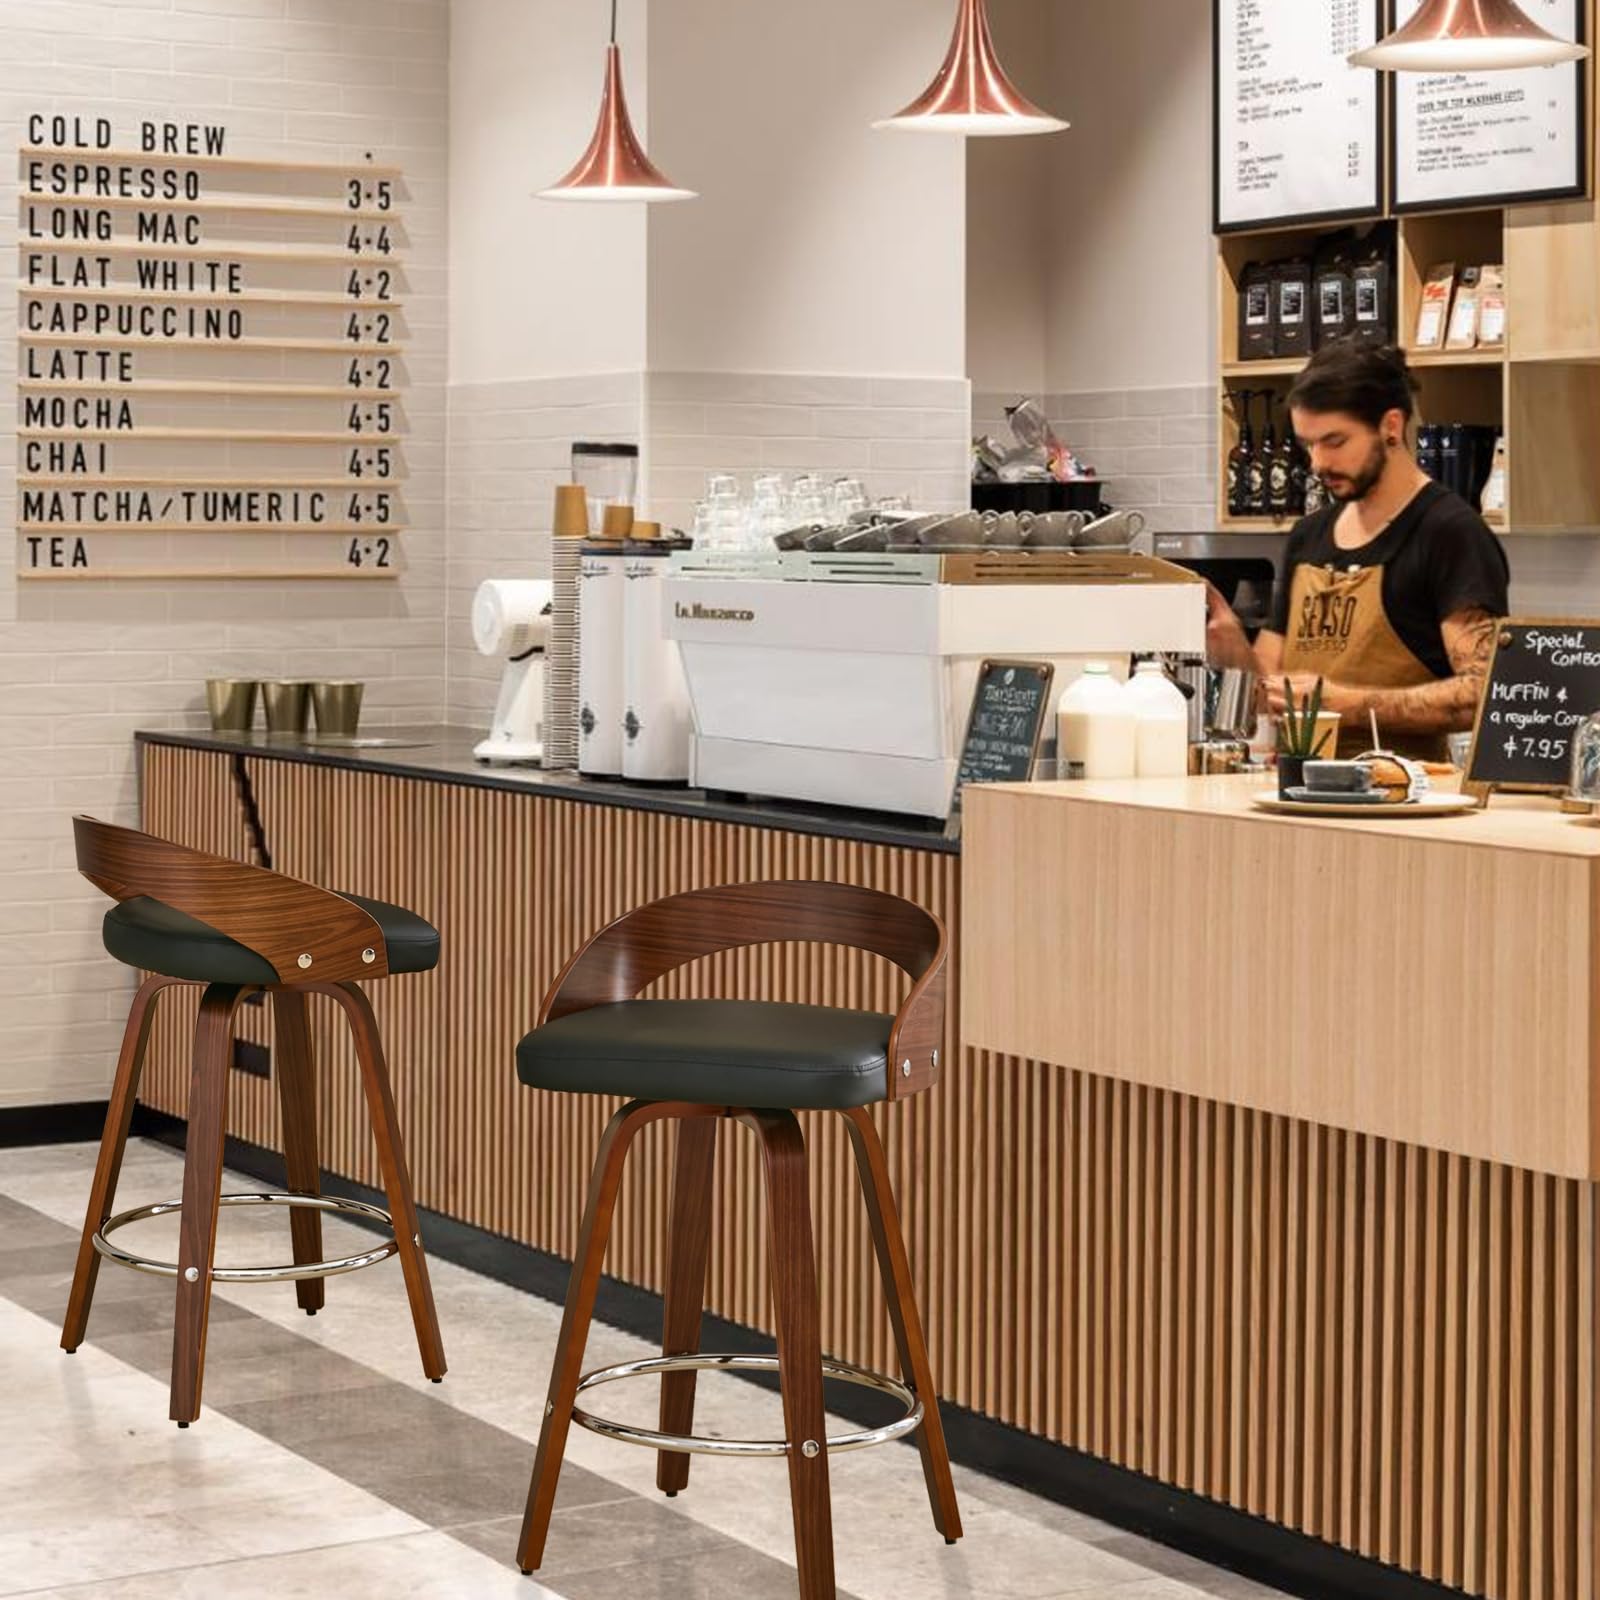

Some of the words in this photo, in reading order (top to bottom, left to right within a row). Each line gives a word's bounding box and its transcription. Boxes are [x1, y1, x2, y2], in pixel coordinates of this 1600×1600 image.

[29, 114, 111, 149] COLD
[142, 122, 225, 156] BREW
[29, 161, 199, 201] ESPRESSO
[29, 206, 111, 241] LONG
[138, 211, 200, 245] MAC
[29, 254, 111, 287] FLAT
[137, 259, 241, 293] WHITE
[28, 300, 242, 340] CAPPUCCINO
[28, 347, 133, 382] LATTE
[25, 397, 133, 430] MOCHA
[26, 441, 106, 473] CHAI
[23, 490, 325, 523] MATCHA/TUMERIC
[27, 537, 88, 568] TEA
[1505, 709, 1551, 729] regular
